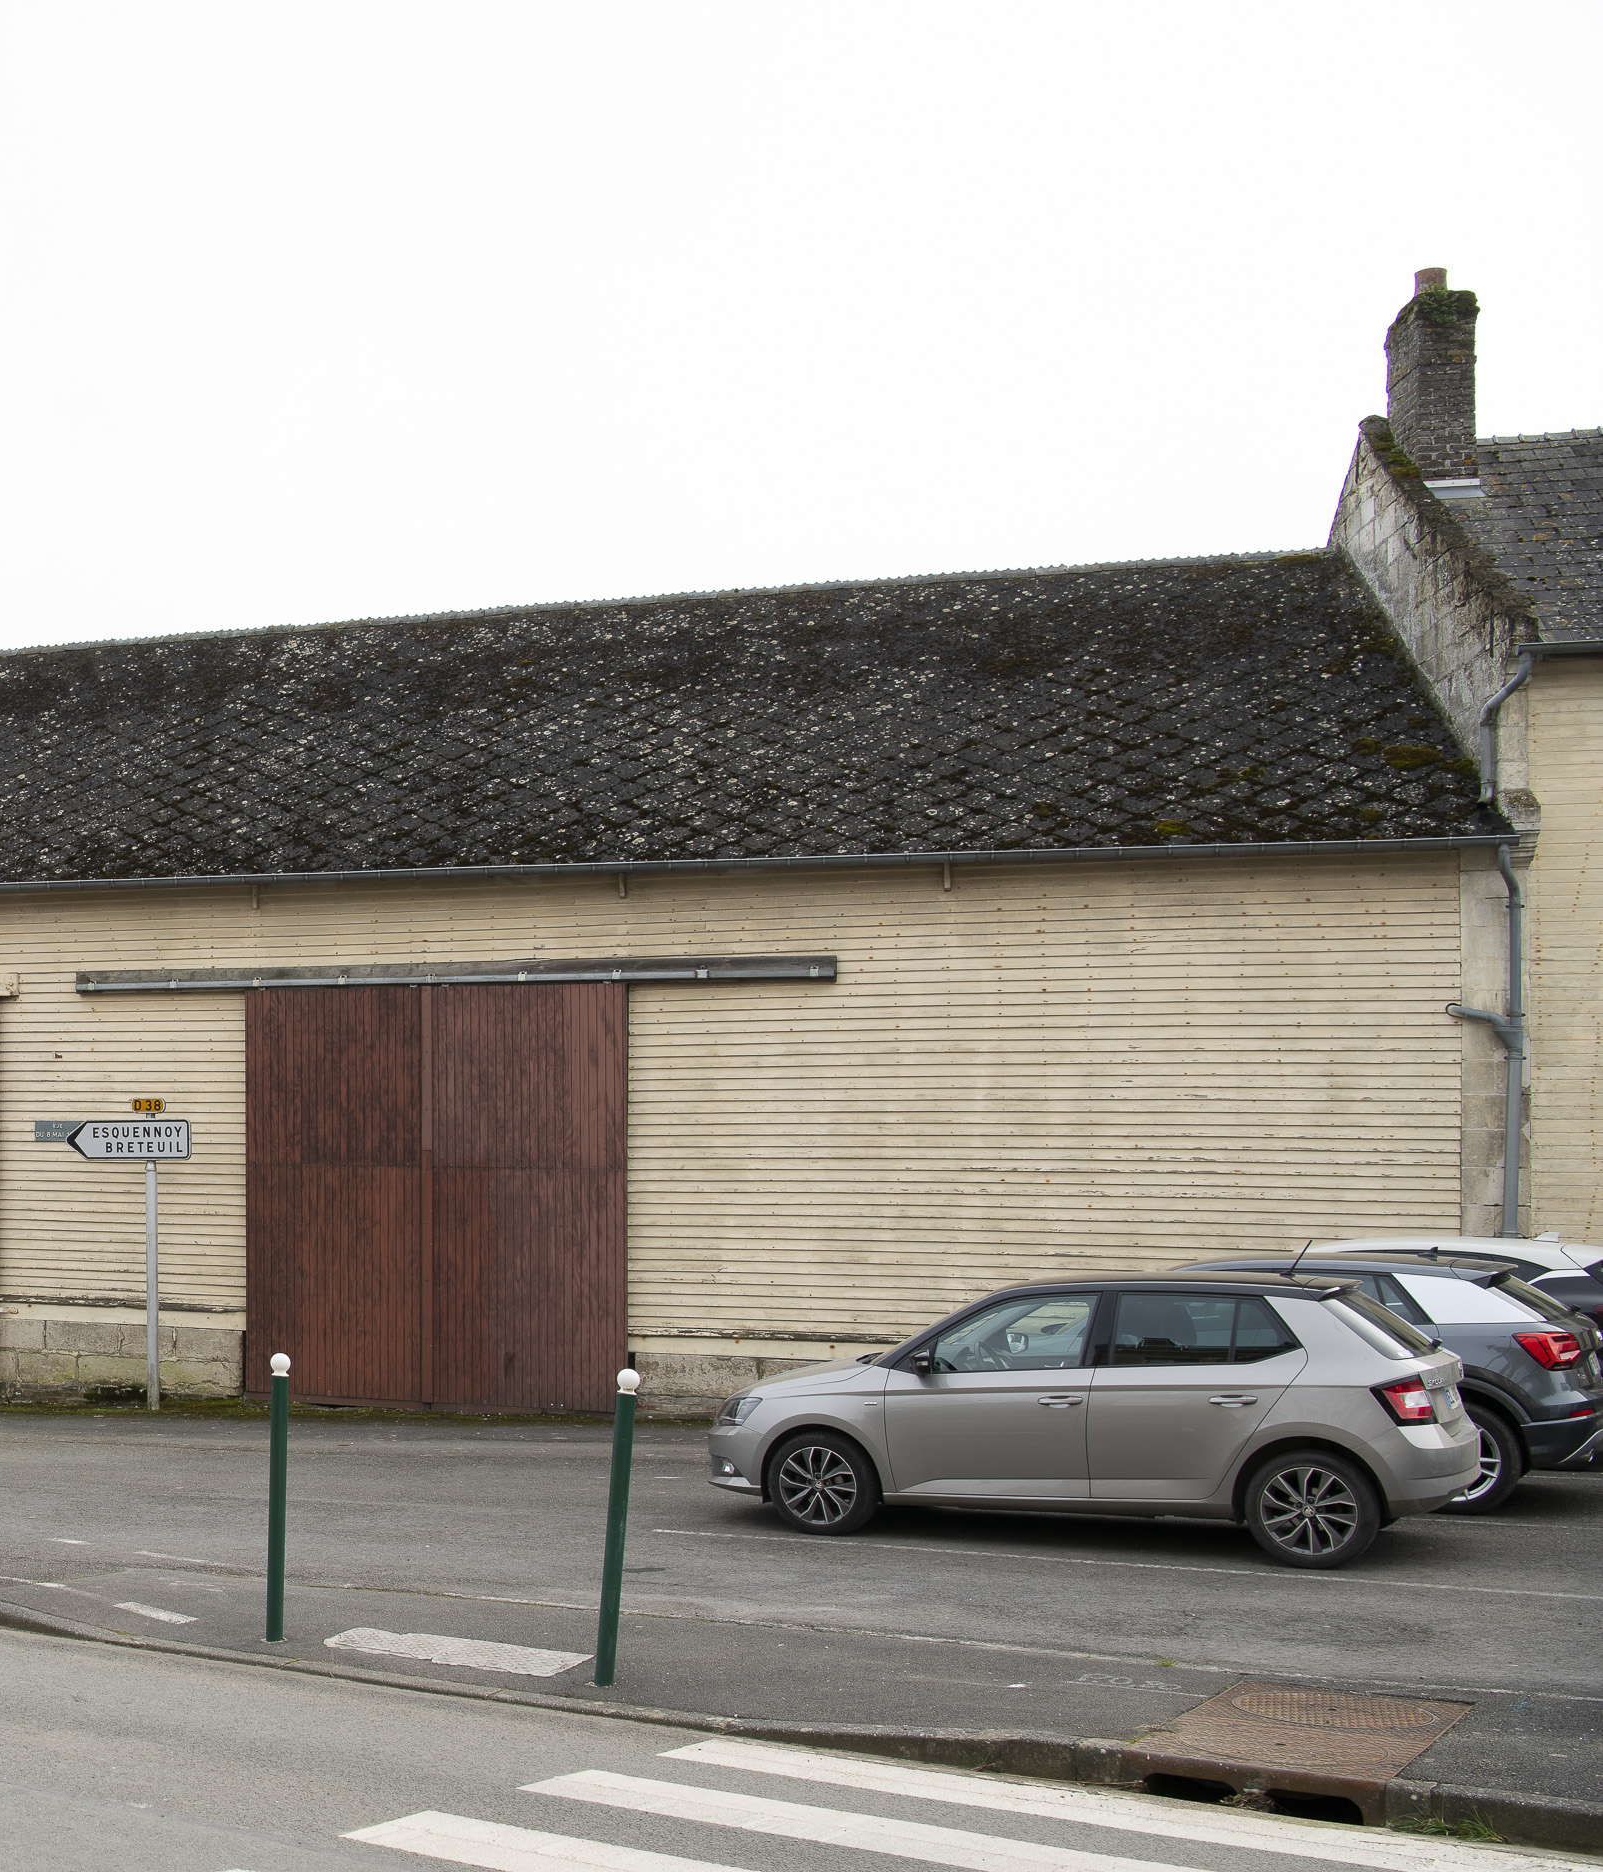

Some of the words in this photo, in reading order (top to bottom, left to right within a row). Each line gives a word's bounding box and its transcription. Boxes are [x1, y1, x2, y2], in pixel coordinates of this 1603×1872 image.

[134, 1099, 142, 1111] D
[145, 1099, 161, 1111] 38
[92, 1126, 182, 1139] ESQUENNOY
[105, 1141, 183, 1153] BRETEUIL
